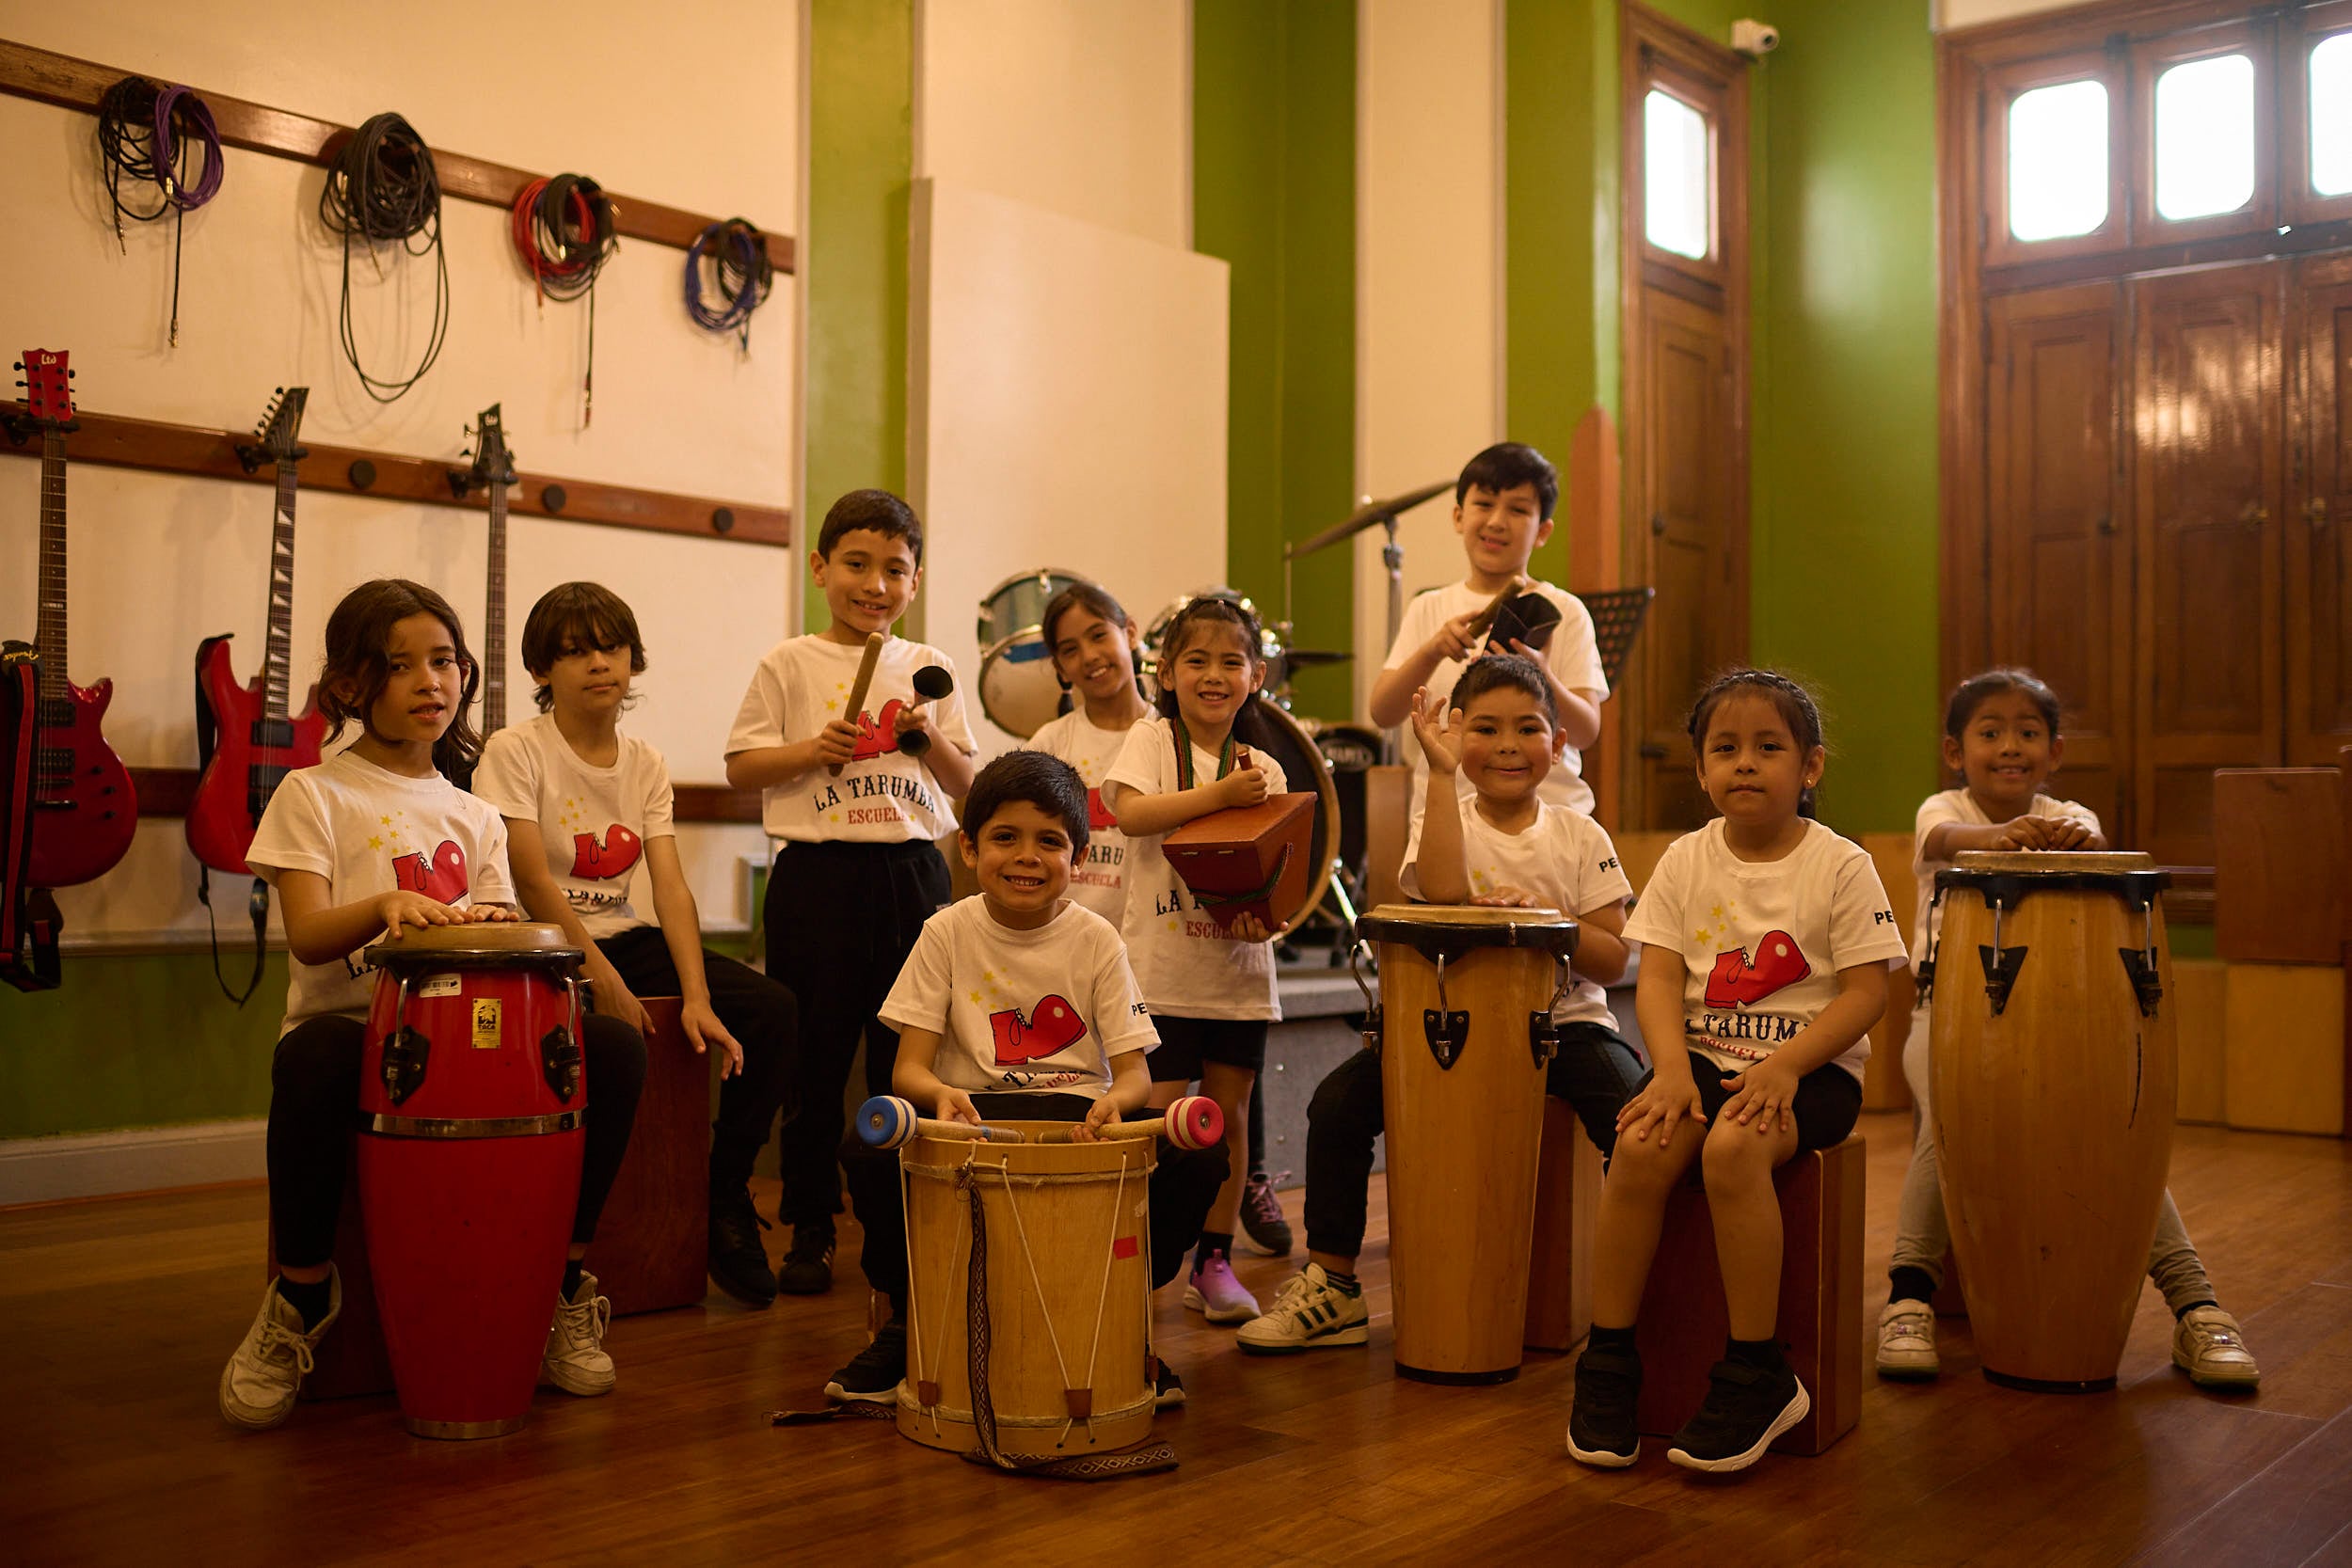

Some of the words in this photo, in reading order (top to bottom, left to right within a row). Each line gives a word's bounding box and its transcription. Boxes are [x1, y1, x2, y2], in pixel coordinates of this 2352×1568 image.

[813, 785, 842, 813] LA
[847, 774, 934, 813] TARUMBA
[848, 807, 908, 824] ESCUEL
[1598, 857, 1618, 873] PE
[1156, 890, 1183, 916] LA
[1874, 911, 1894, 925] PE
[1131, 1003, 1148, 1016] PE
[1704, 1013, 1808, 1042] TARUM
